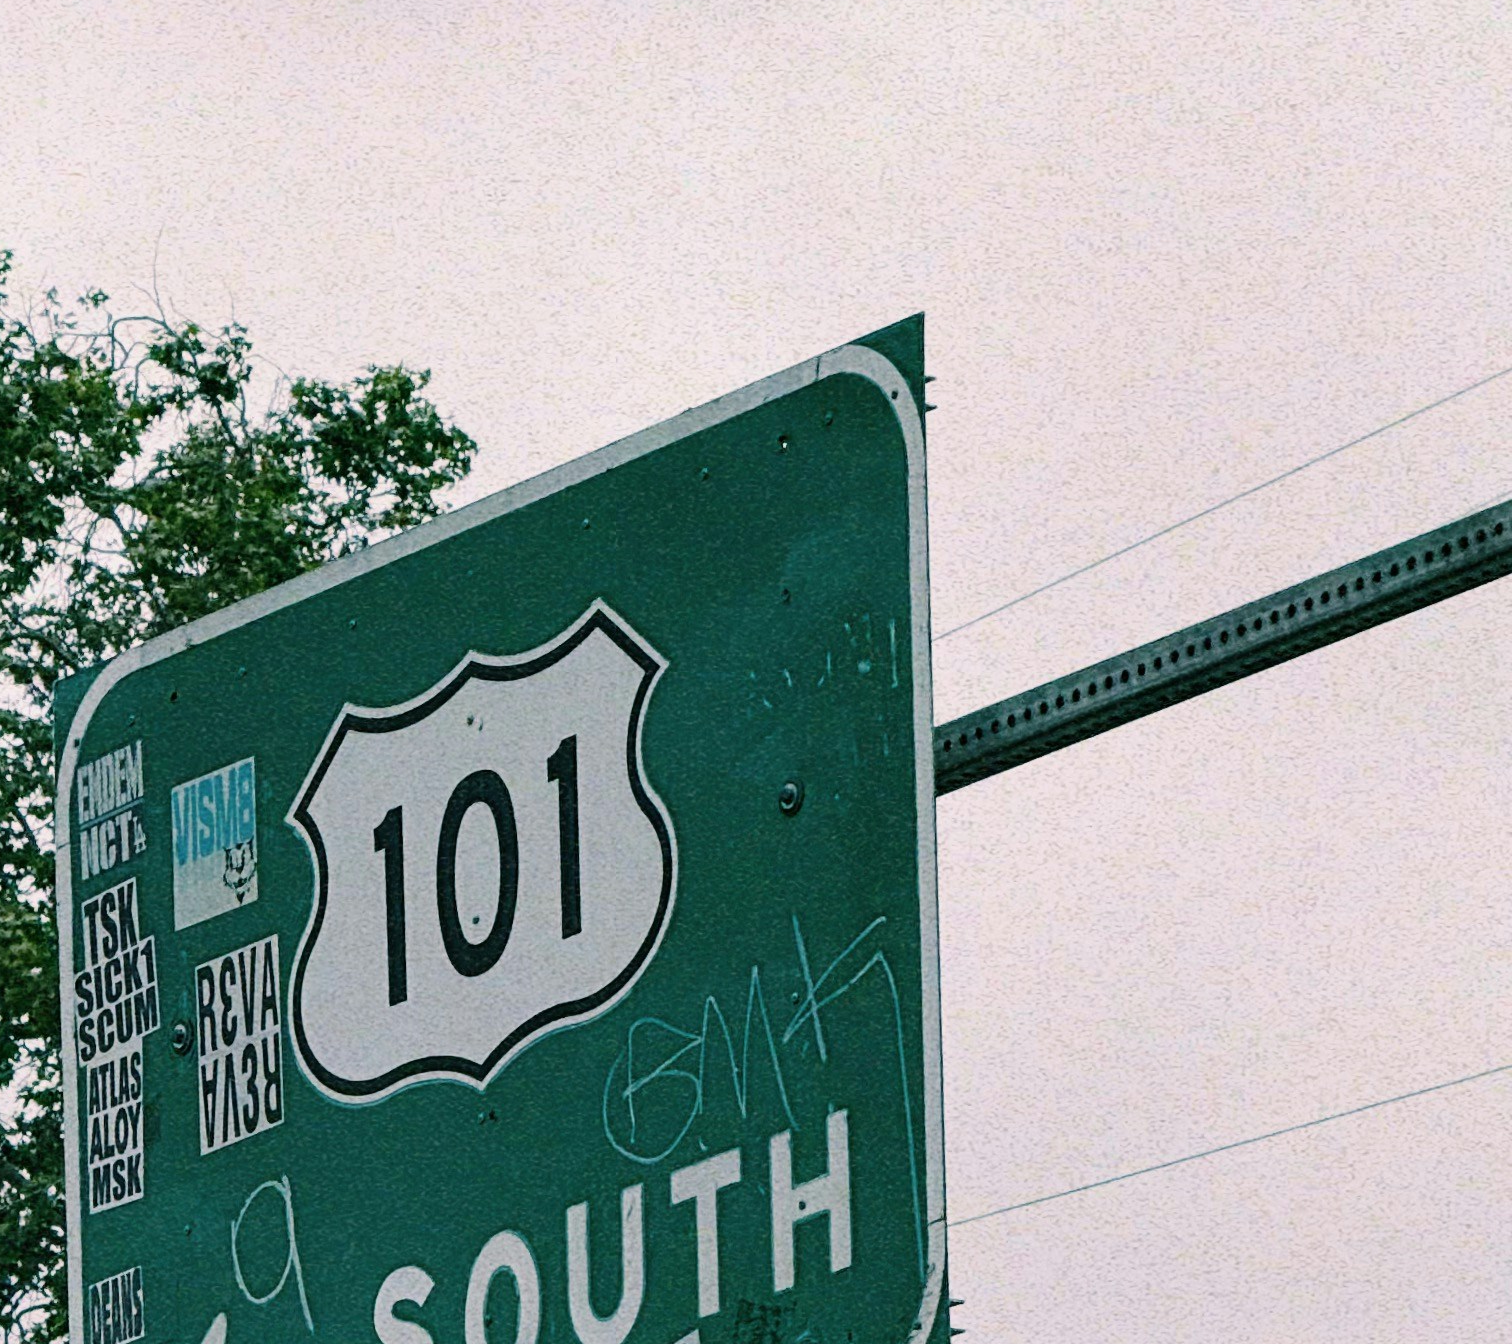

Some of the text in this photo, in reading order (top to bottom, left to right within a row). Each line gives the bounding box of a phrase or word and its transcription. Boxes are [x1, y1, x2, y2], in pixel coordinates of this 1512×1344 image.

[373, 734, 582, 1006] 101
[83, 882, 138, 966] TSK
[74, 939, 155, 1018] SICK1
[79, 985, 158, 1062] SCUM
[89, 1052, 141, 1116] ATLAS
[90, 1102, 141, 1165] ALOY
[92, 1153, 142, 1208] MSK
